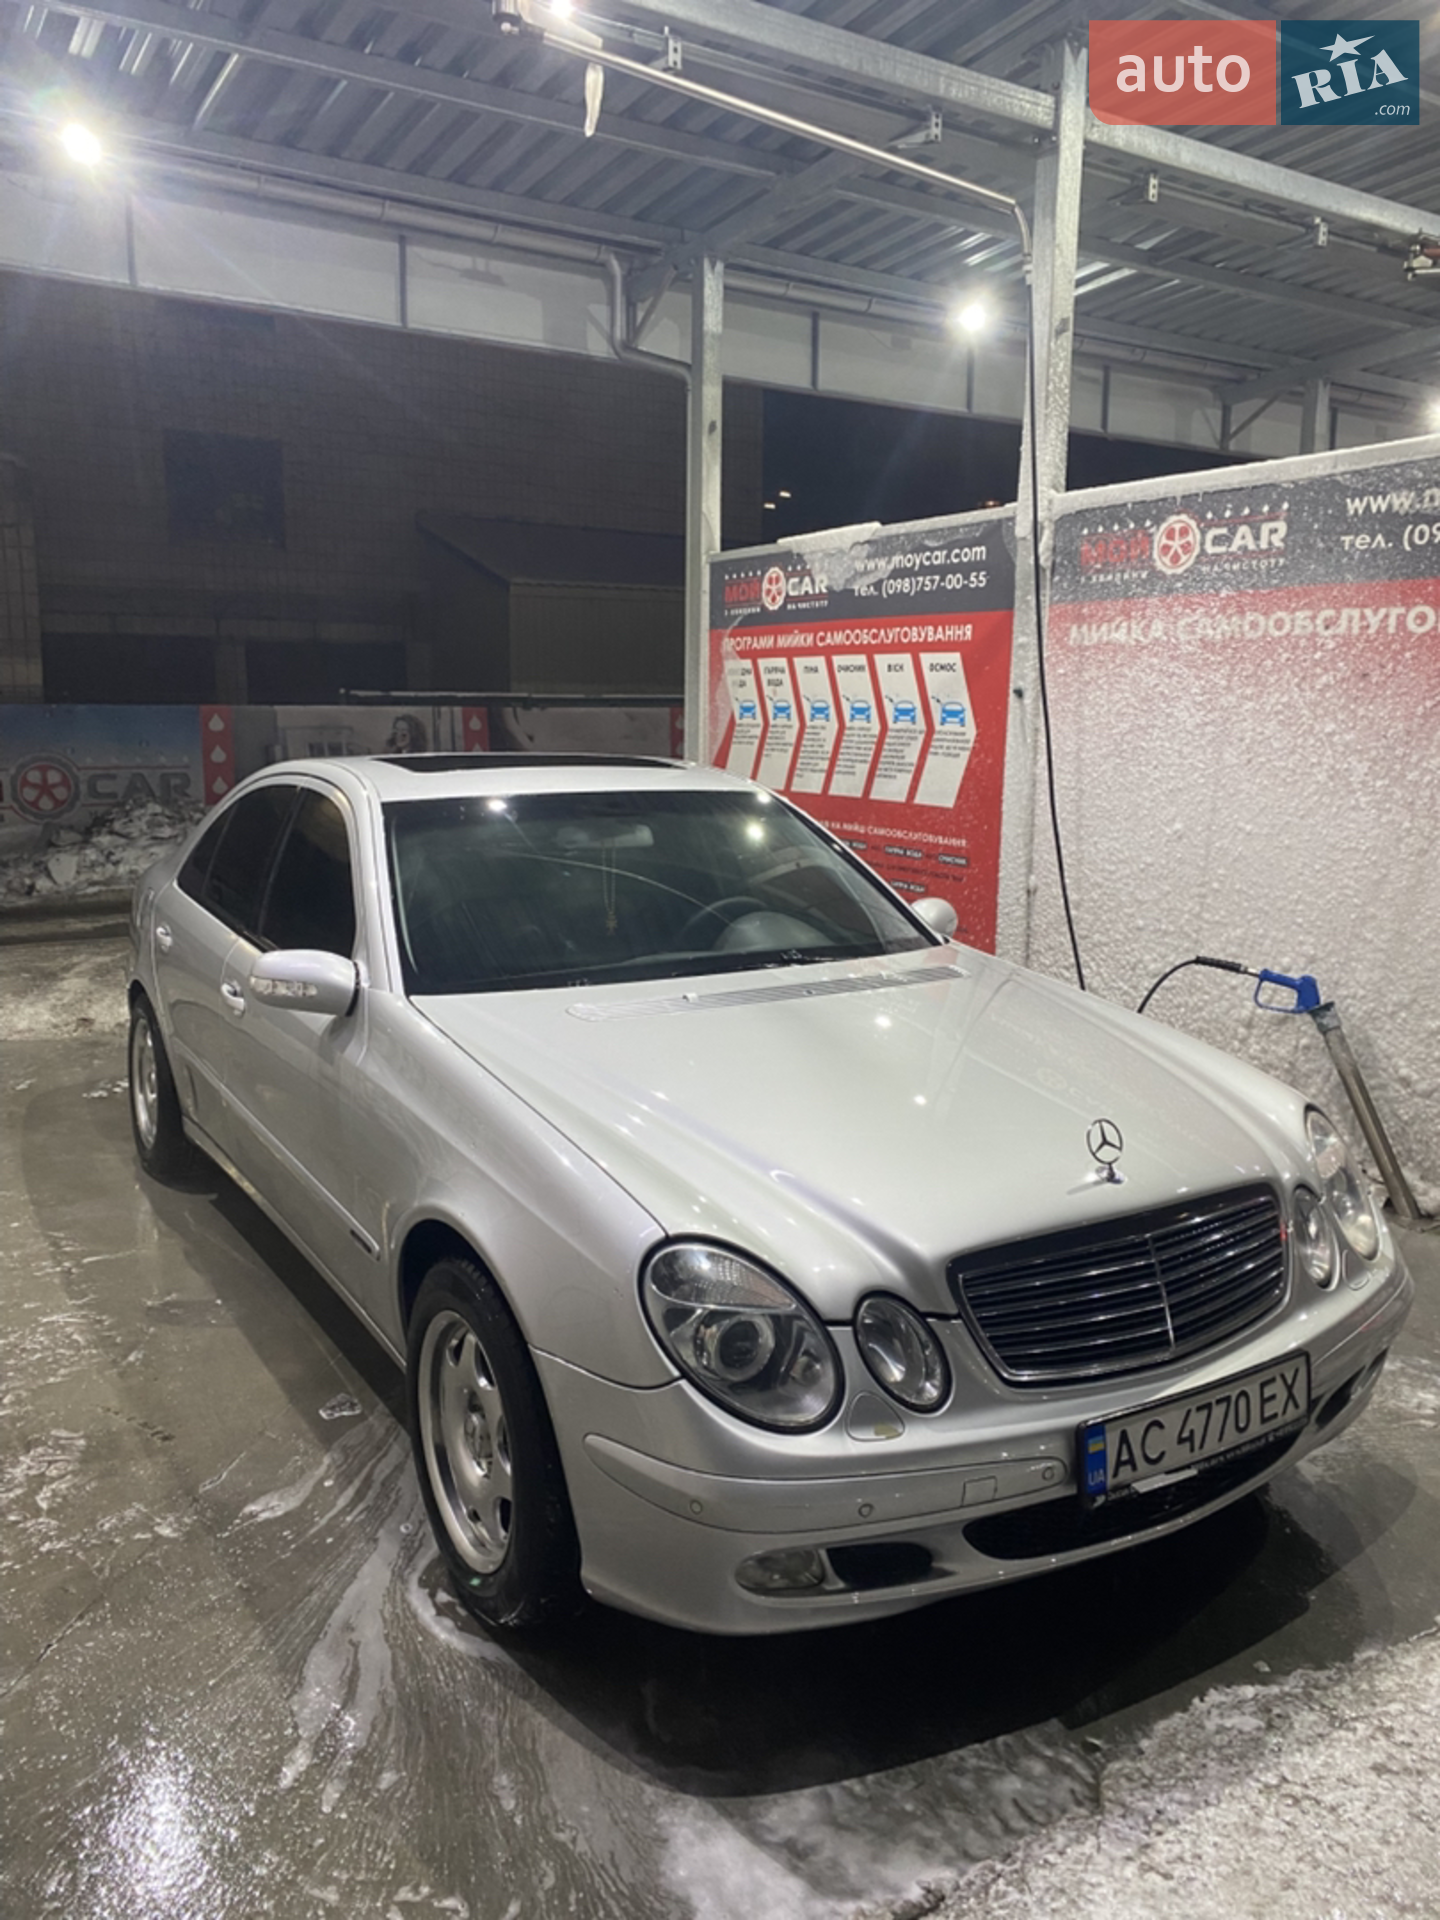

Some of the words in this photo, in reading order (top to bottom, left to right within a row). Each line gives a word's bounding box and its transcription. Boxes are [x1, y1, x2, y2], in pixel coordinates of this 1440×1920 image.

[1204, 520, 1288, 555] CAR
[1341, 533, 1393, 551] тел.
[787, 575, 828, 597] CAR
[881, 571, 988, 598] (098)757-00-55
[816, 624, 973, 647] САМООБСЛУГОВУВАННЯ
[1176, 604, 1440, 641] САМООБСЛУГО
[1112, 1418, 1166, 1479] AC
[1176, 1389, 1250, 1453] 4770
[1259, 1367, 1300, 1425] EX
